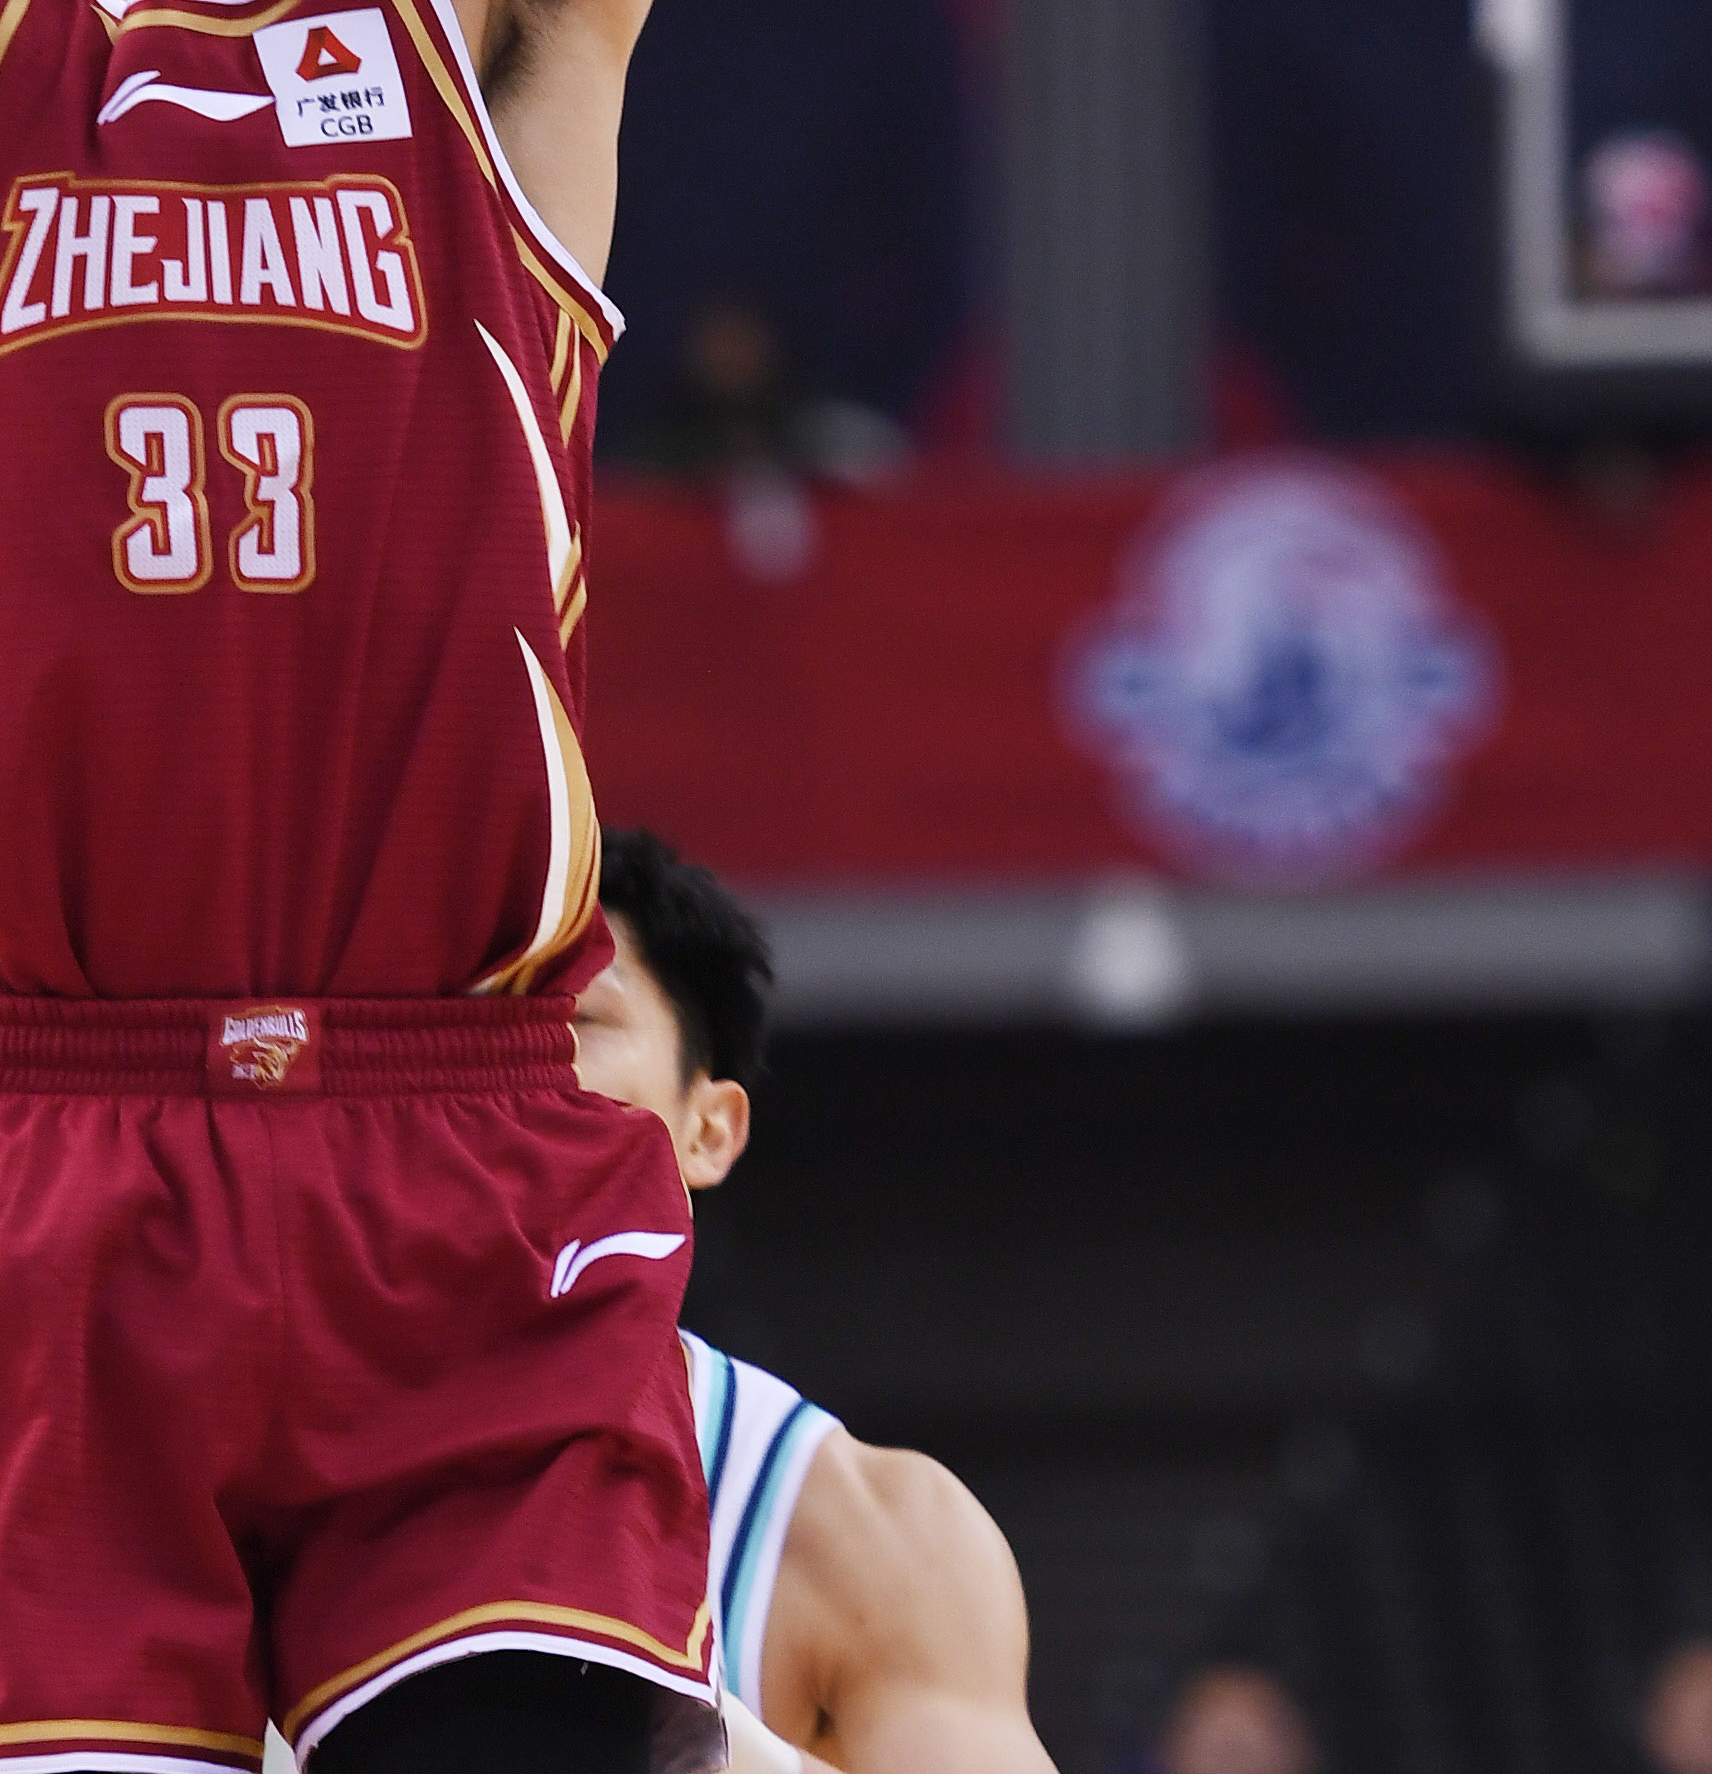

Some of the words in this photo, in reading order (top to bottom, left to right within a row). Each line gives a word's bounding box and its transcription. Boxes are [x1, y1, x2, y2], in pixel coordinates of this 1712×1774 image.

[296, 86, 385, 117] 广发银行
[320, 114, 374, 138] CGB
[0, 186, 416, 335] ZHEJIANG
[110, 399, 310, 588] 33
